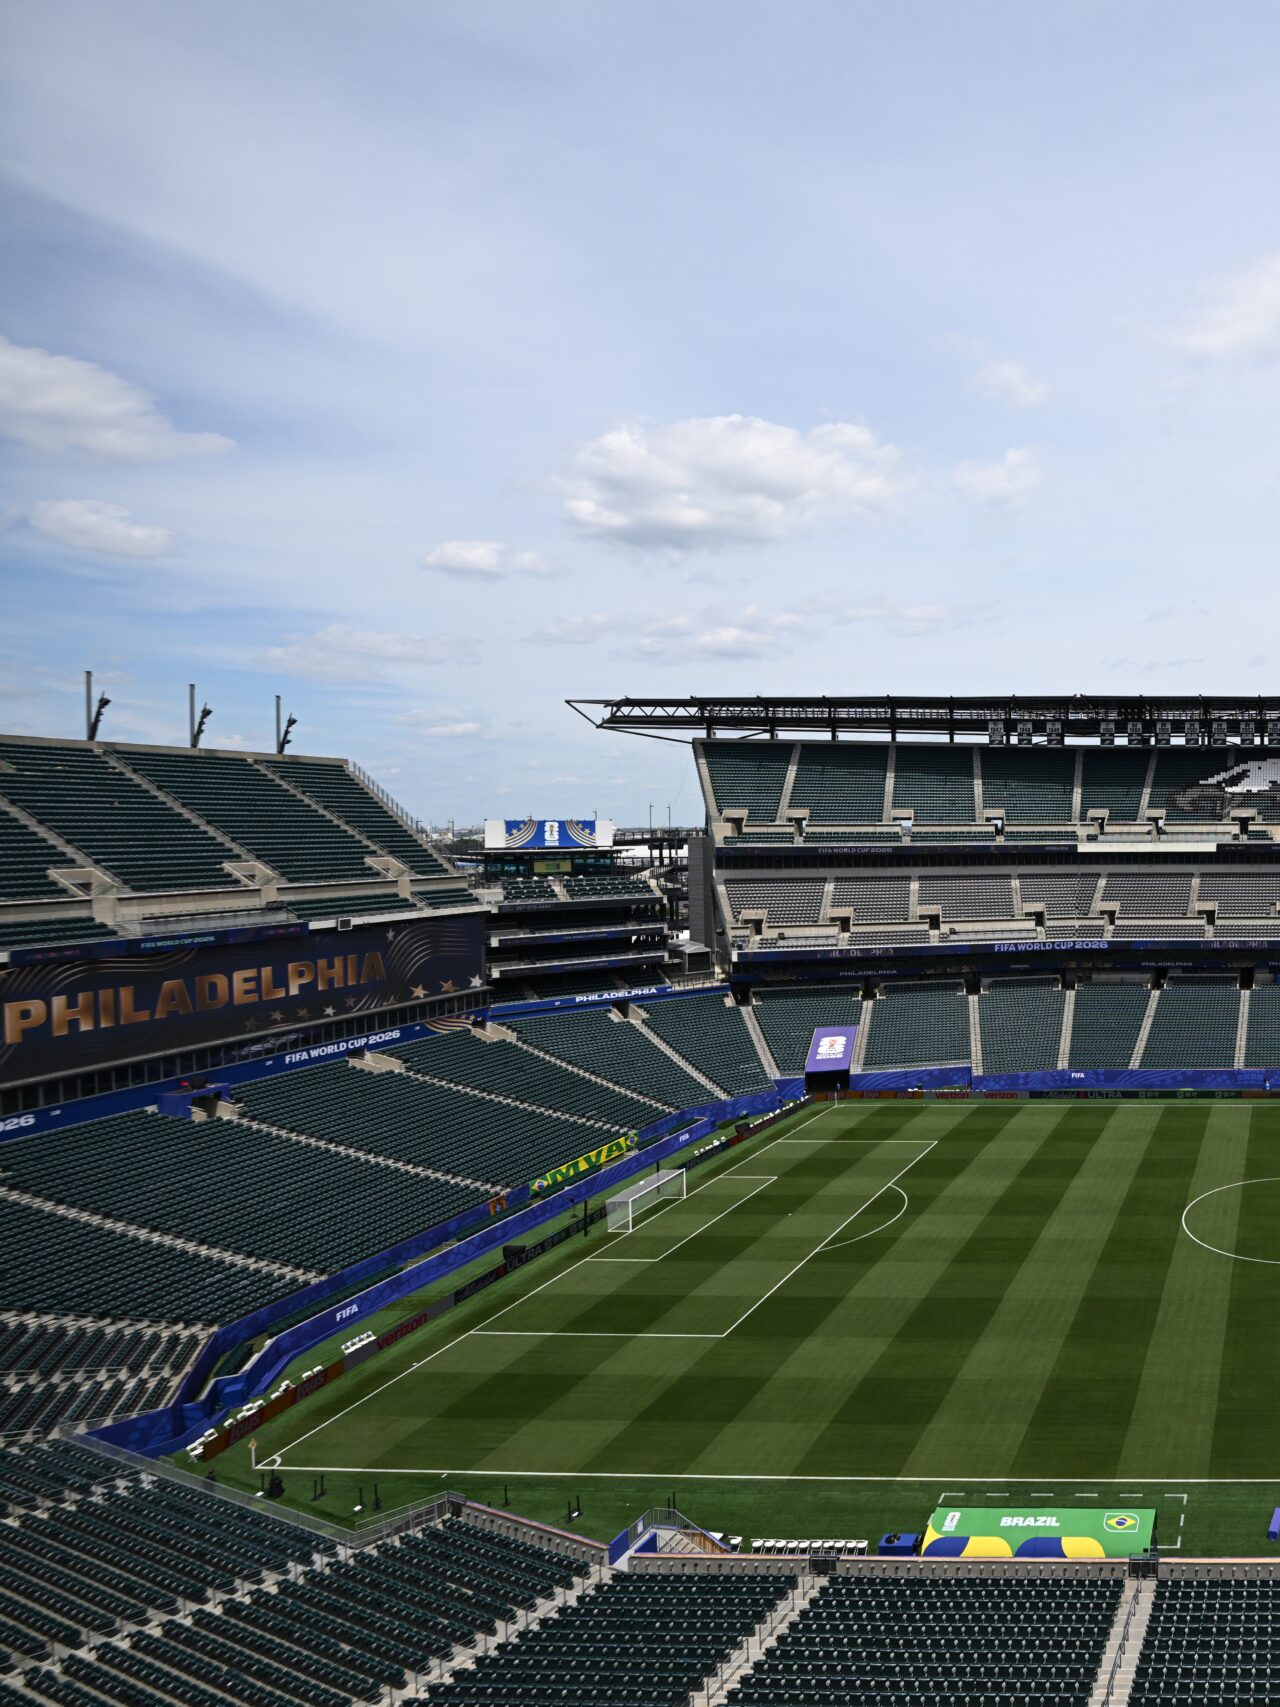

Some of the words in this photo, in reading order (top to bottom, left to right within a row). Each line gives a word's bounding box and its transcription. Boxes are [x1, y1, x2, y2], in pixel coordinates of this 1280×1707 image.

[994, 944, 1016, 952] FIFA
[1017, 943, 1052, 951] WORLD
[1075, 941, 1108, 949] 2026
[4, 952, 386, 1044] PHILADELPHIA
[575, 987, 657, 1003] PHILADELPHIA
[285, 1051, 309, 1065] FIFA
[309, 1043, 347, 1058] WORLD
[348, 1037, 367, 1049] CUP
[368, 1029, 401, 1045] 2026
[679, 1132, 690, 1143] FIFA
[550, 1139, 625, 1184] MVA
[506, 1246, 543, 1272] ULTRA
[335, 1304, 359, 1323] FIFA
[377, 1312, 428, 1351] verizon
[1000, 1516, 1060, 1527] BRAZIL
